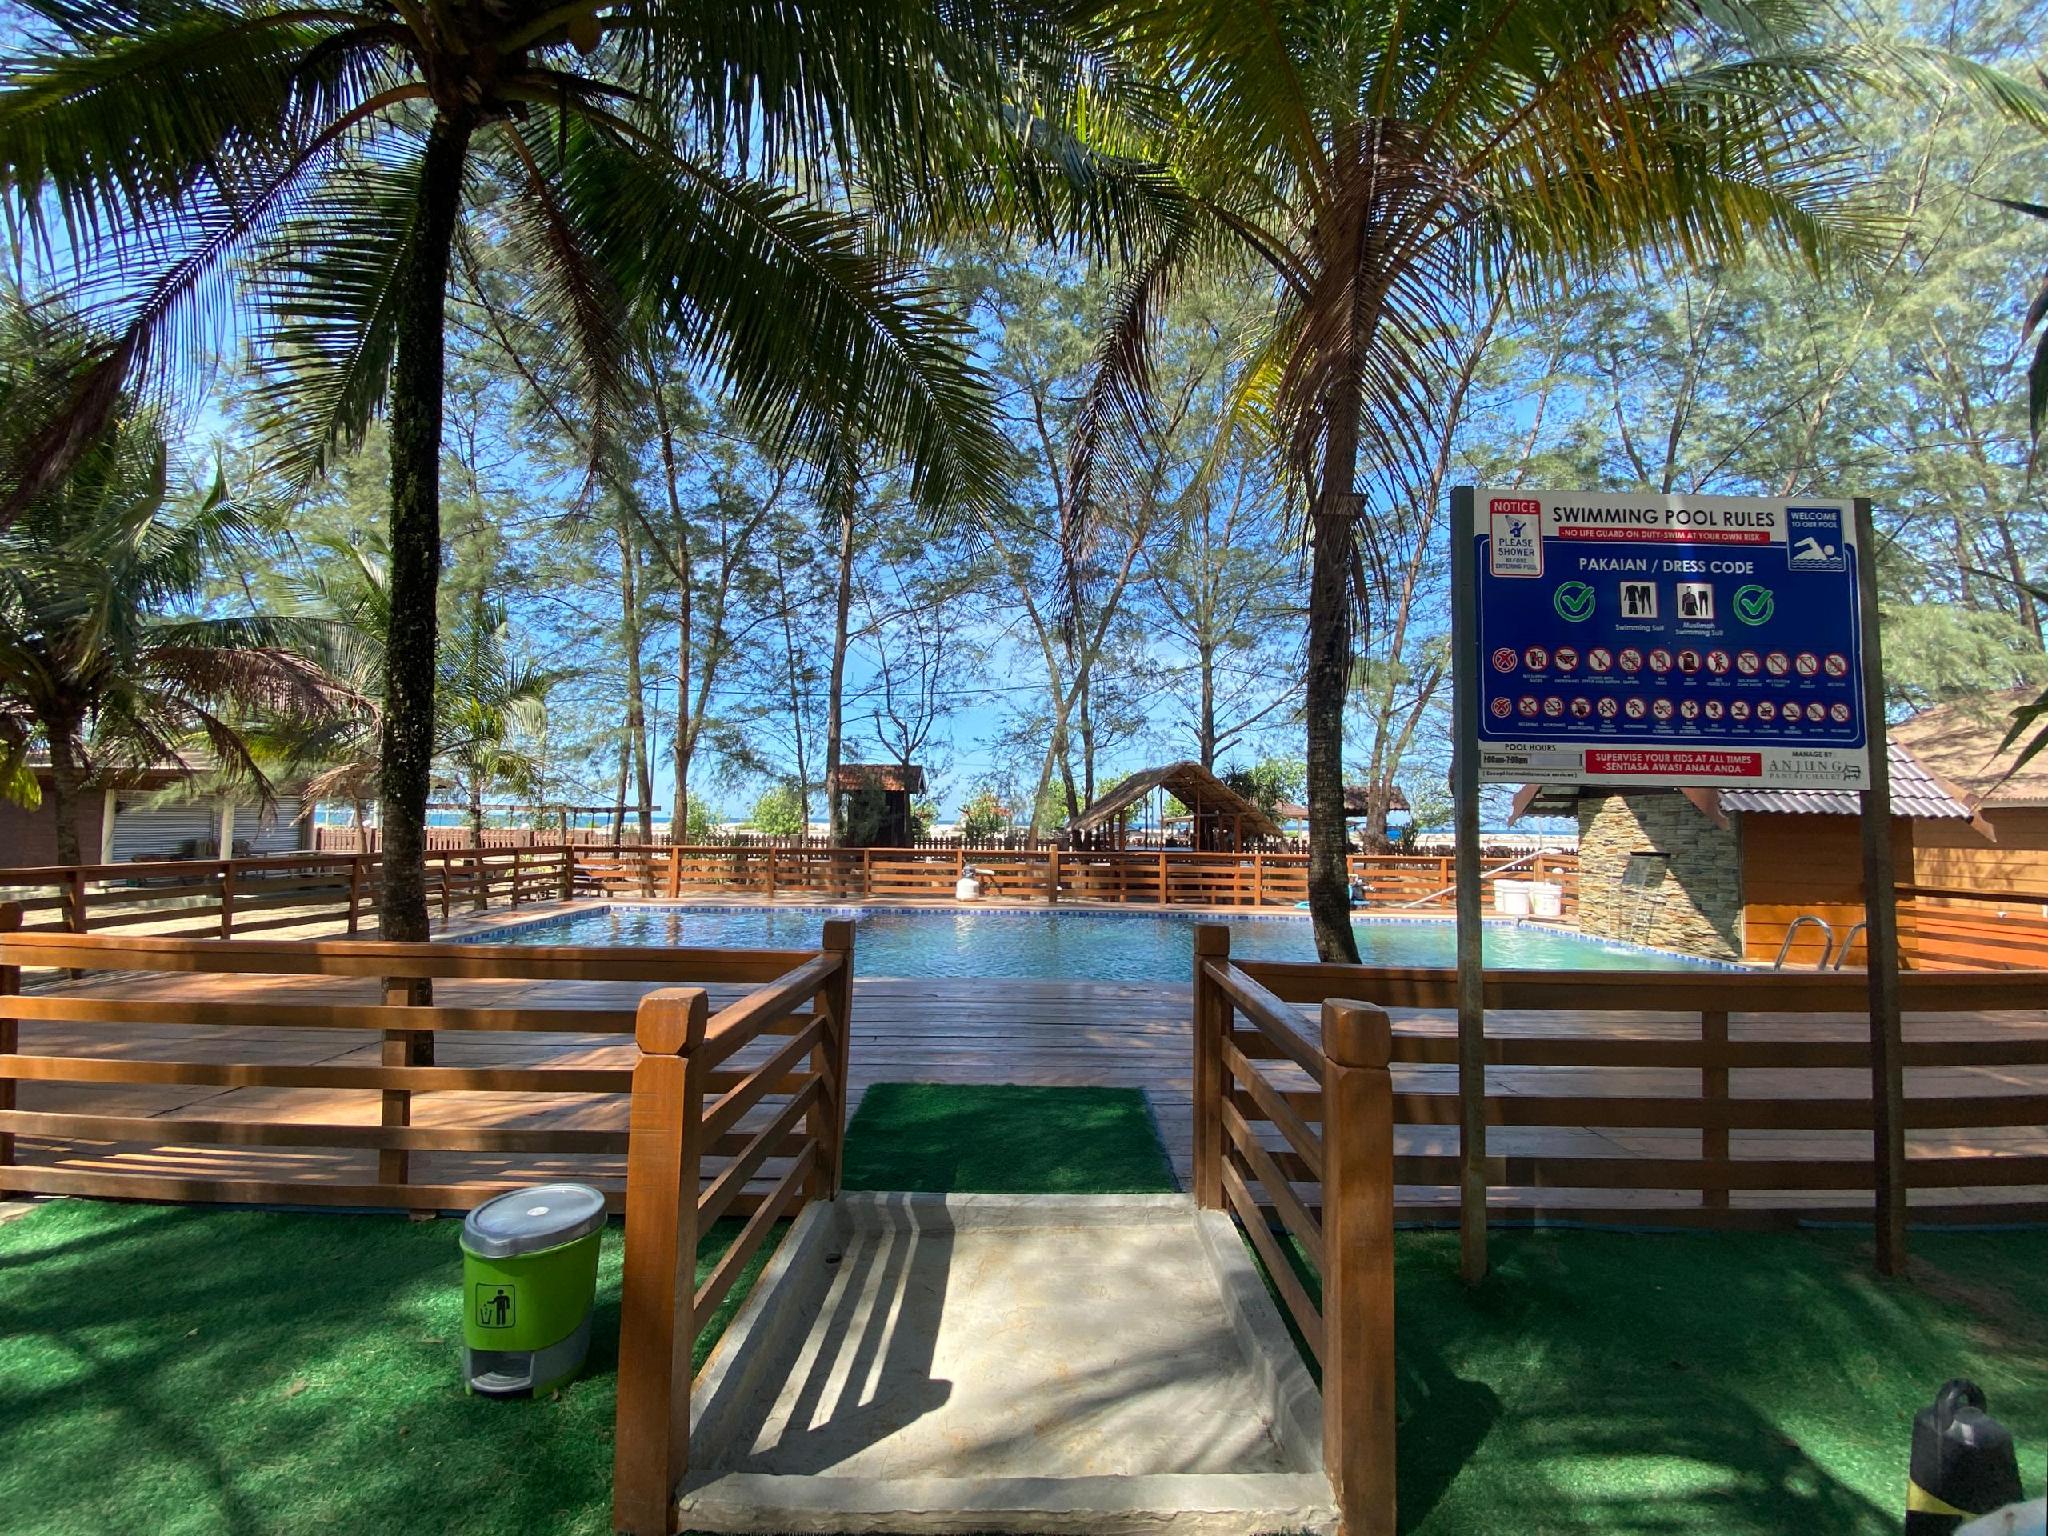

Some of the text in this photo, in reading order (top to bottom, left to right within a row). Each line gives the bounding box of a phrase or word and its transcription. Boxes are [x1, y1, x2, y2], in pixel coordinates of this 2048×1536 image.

[1494, 501, 1536, 512] NOTICE
[1553, 506, 1775, 527] SWIMMING POOL RULES
[1790, 512, 1837, 520] WELCOME
[1596, 530, 1624, 538] GUARD
[1498, 538, 1533, 546] PLEASE
[1498, 548, 1535, 556] SHOWER
[1579, 558, 1754, 574] PAKAIAN / DRESS CODE
[1615, 624, 1650, 632] Swimming
[1675, 628, 1710, 637] Swimming
[1596, 753, 1752, 764] SUPERVISE YOUR KIDS AT ALL TIMES
[1685, 764, 1712, 772] ANAK
[1714, 765, 1745, 773] ANDA-
[1768, 760, 1843, 773] ANJUNG
